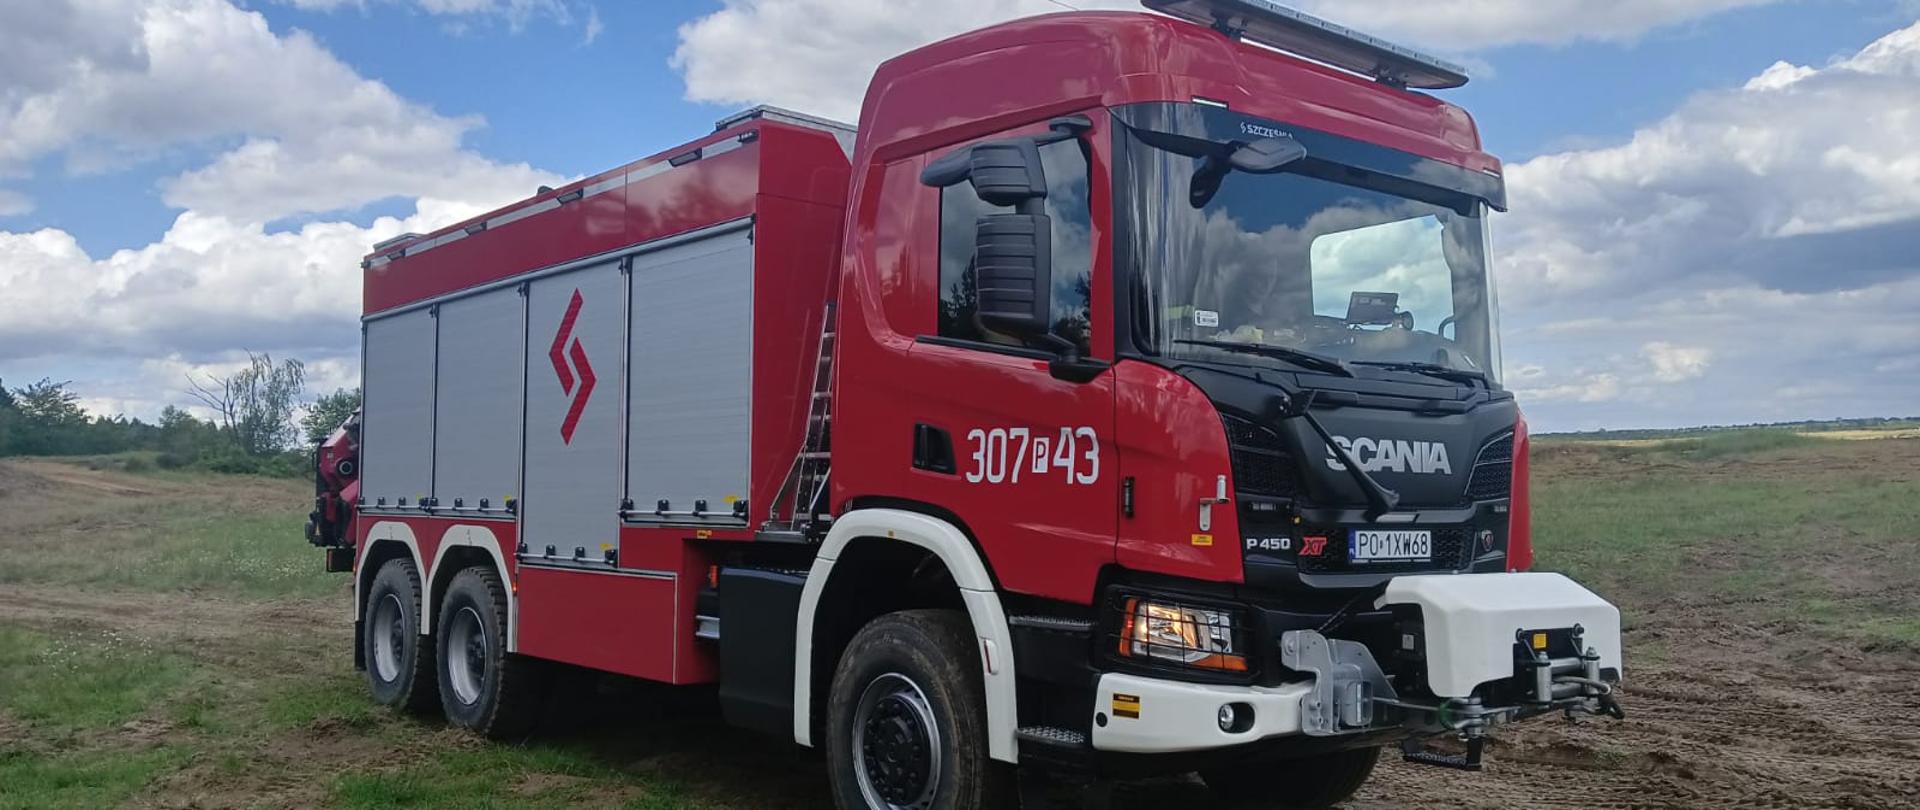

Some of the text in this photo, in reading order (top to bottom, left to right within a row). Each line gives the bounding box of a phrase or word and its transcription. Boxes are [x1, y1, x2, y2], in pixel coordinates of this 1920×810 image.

[965, 427, 1100, 484] 307 P 43
[1326, 435, 1452, 475] SCANIA
[1246, 538, 1291, 550] P 450
